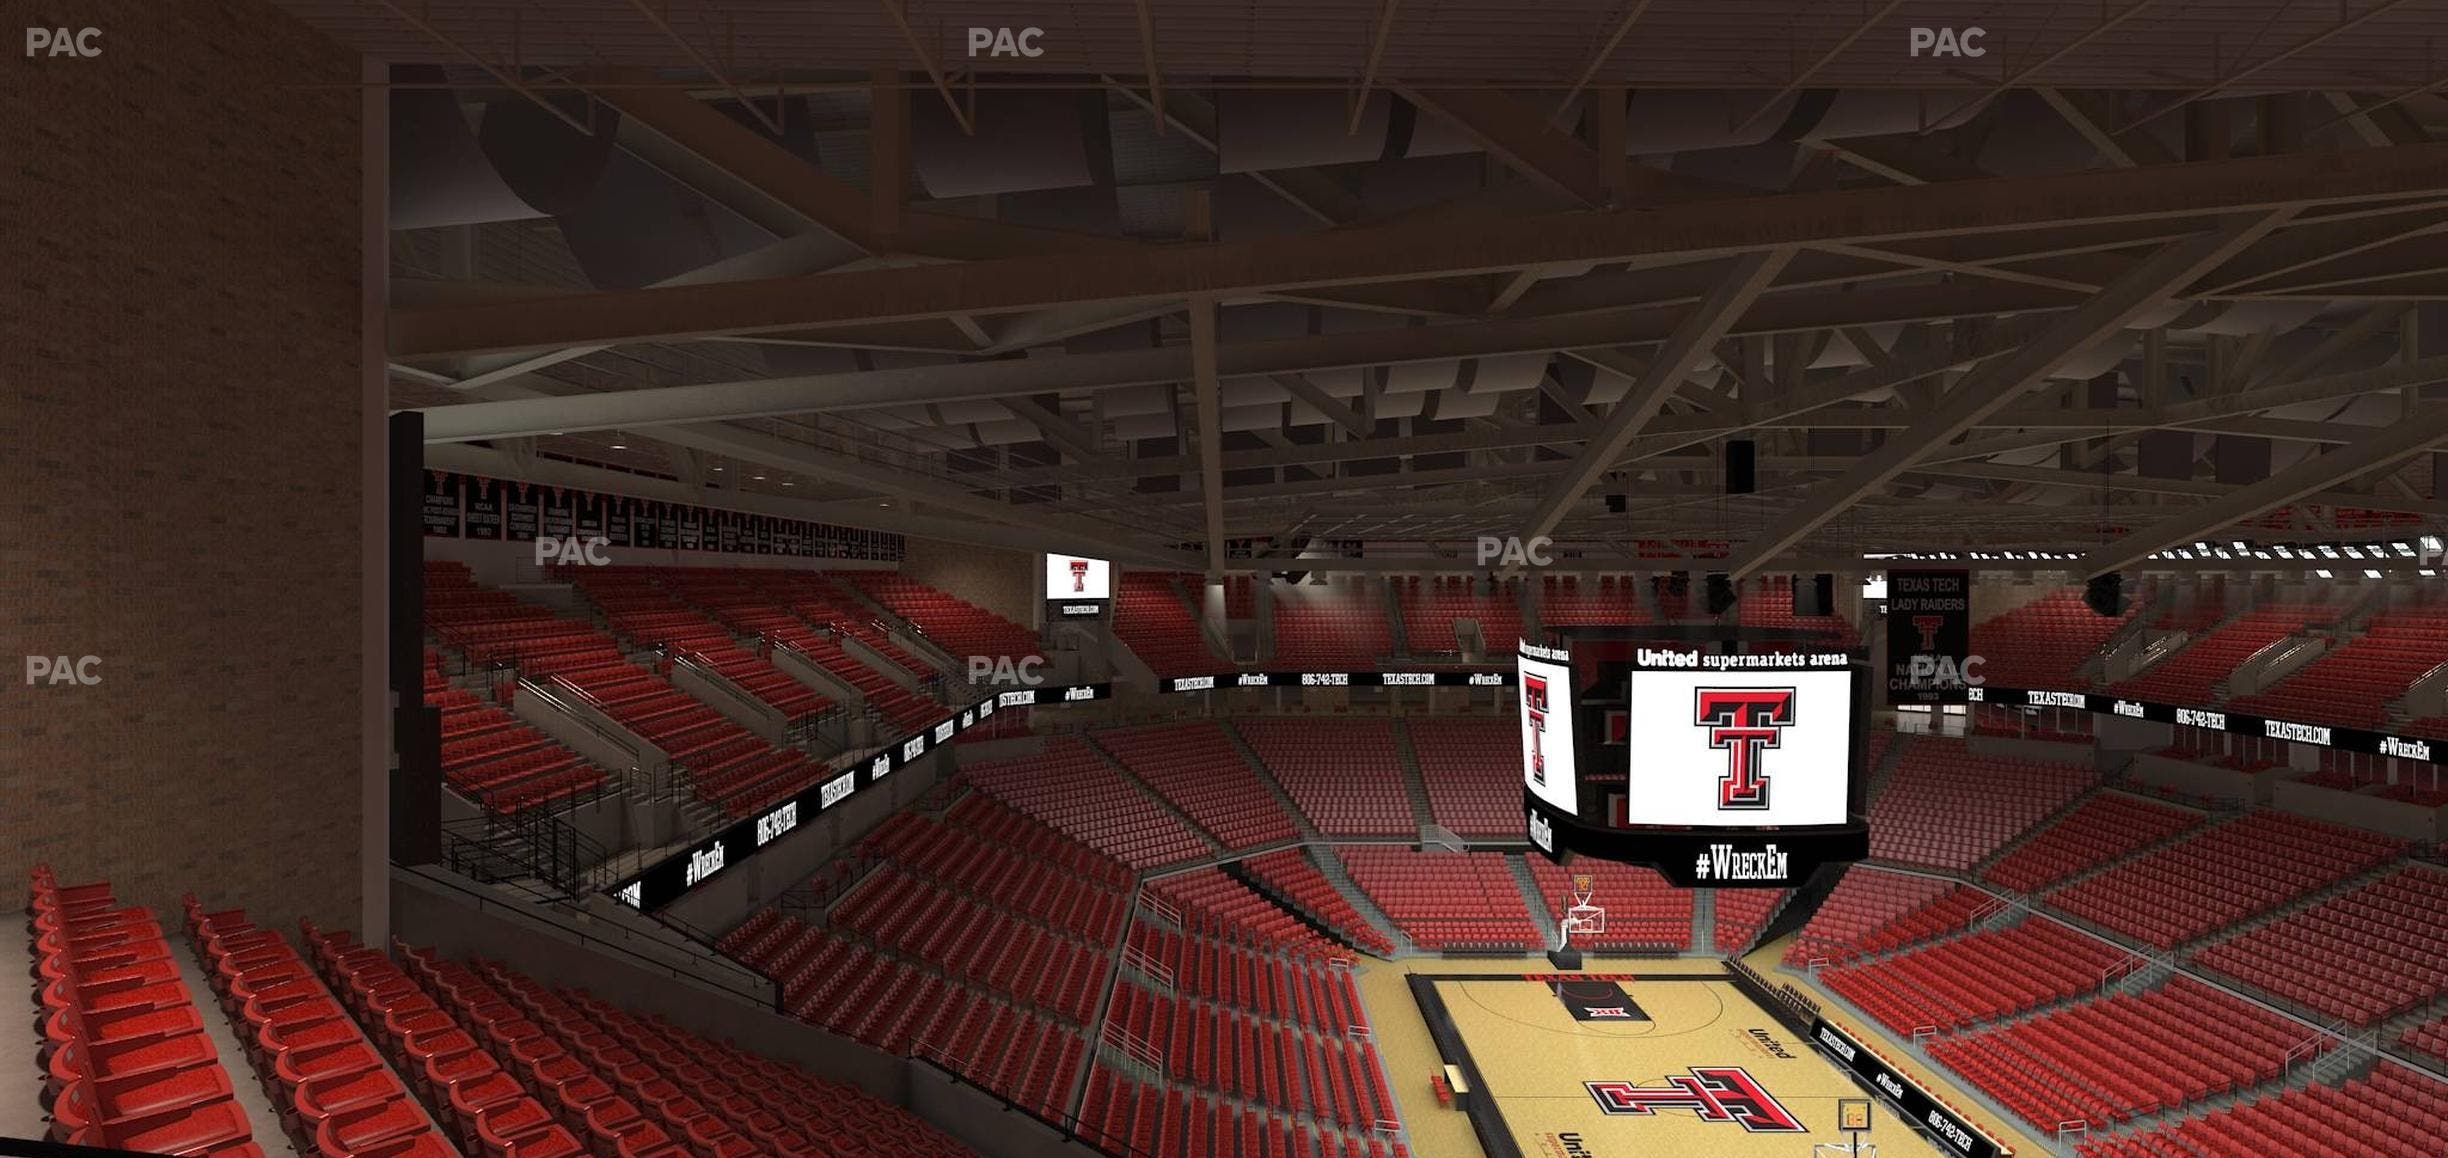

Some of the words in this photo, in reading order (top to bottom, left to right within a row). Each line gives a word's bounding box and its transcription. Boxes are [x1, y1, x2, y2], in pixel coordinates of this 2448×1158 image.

[1896, 577, 1930, 592] TEXAS
[1933, 578, 1960, 592] TECH
[1891, 598, 1919, 611] LADY
[1920, 598, 1966, 611] RAIDERS
[1637, 648, 1698, 667] United
[1702, 651, 1806, 671] supermarkets
[1809, 653, 1849, 666] arena
[1301, 673, 1349, 686] 806-742-TECH
[1382, 673, 1435, 686] TEXASTECH.COM
[1889, 677, 1967, 691] CHAMPIONS
[2176, 708, 2226, 731] 806-742-TECH
[2265, 720, 2332, 746] TEXASTECH.COM
[1748, 1028, 1798, 1059] United
[1928, 1110, 1974, 1152] 806-742-TECH
